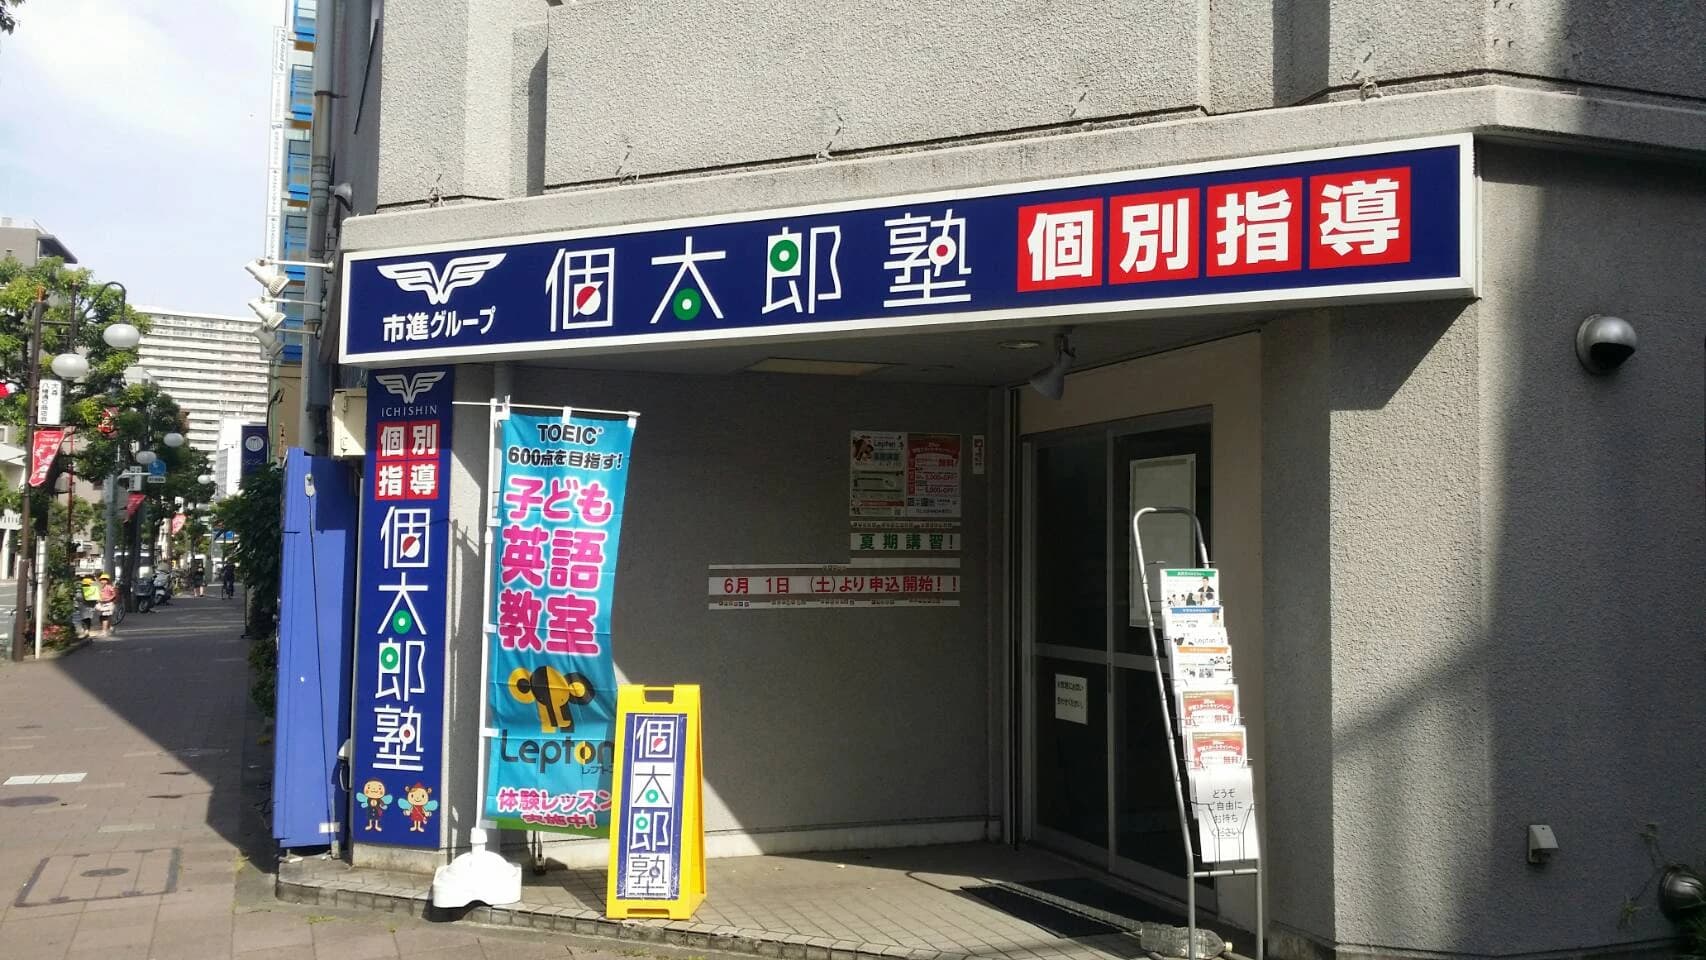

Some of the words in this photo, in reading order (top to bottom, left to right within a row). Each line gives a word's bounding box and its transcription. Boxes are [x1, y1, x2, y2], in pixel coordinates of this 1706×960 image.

[545, 207, 972, 333] 個太郎塾
[1026, 177, 1401, 282] 個別指導
[383, 306, 496, 343] 市進グループ
[381, 404, 438, 417] ICHISHIN
[380, 423, 437, 458] 個別
[508, 447, 623, 470] 600点を目指す!
[378, 464, 438, 497] 指導
[506, 477, 613, 524] 子ども
[502, 525, 606, 588] 英語
[860, 534, 953, 550] 夏期講習!
[500, 588, 601, 654] 教室
[372, 506, 430, 772] 個太郎塾
[501, 729, 614, 774] Lepton
[498, 788, 612, 811] 体験レッスン
[629, 718, 674, 897] 個太郎塾
[1210, 800, 1244, 811] ご自由に
[1212, 788, 1236, 799] どうぞ
[522, 813, 597, 828] 実施中!
[1211, 827, 1241, 838] ください
[1213, 813, 1239, 824] お持ち
